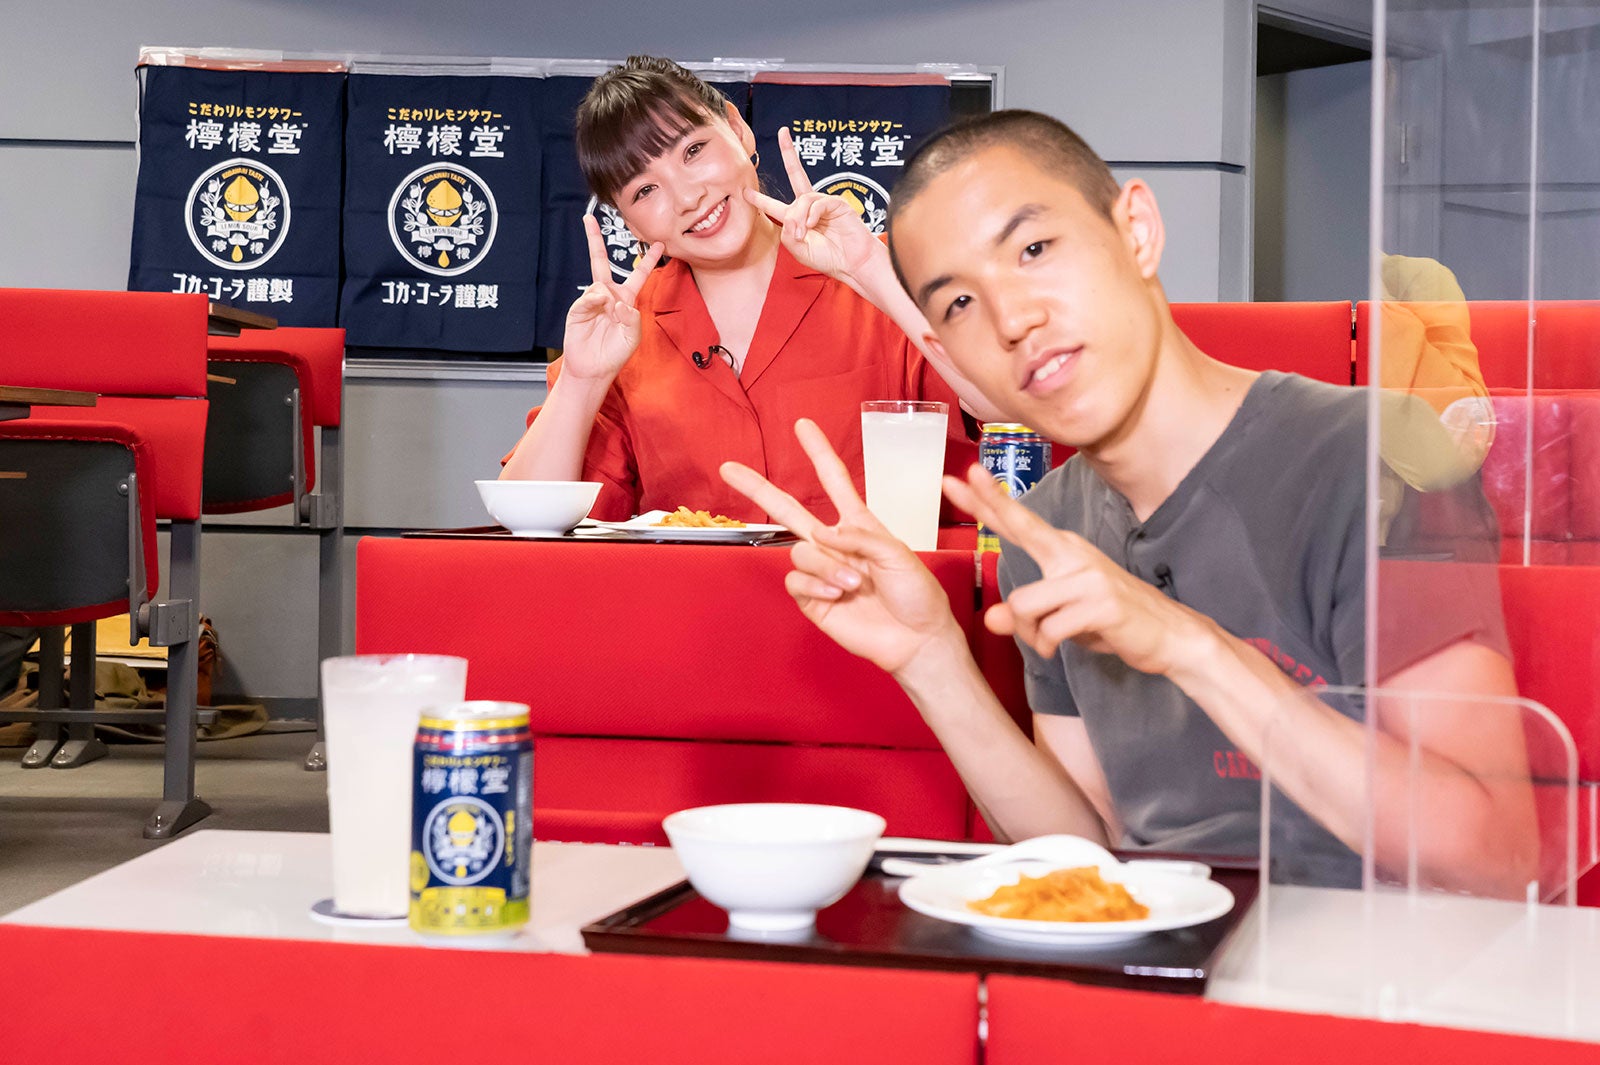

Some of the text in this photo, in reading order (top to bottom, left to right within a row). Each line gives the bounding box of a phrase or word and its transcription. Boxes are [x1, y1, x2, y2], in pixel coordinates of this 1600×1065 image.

[188, 102, 302, 120] こだわりレモンサワー
[387, 107, 502, 123] こだわりレモンサワー
[185, 118, 302, 154] 檸檬堂
[383, 123, 504, 158] 檸檬堂
[793, 119, 903, 133] こだわりレモンサワー
[793, 134, 905, 167] 檸檬堂
[172, 272, 293, 303] コカ・コーラ謹製
[381, 281, 498, 309] コカ・コーラ謹製
